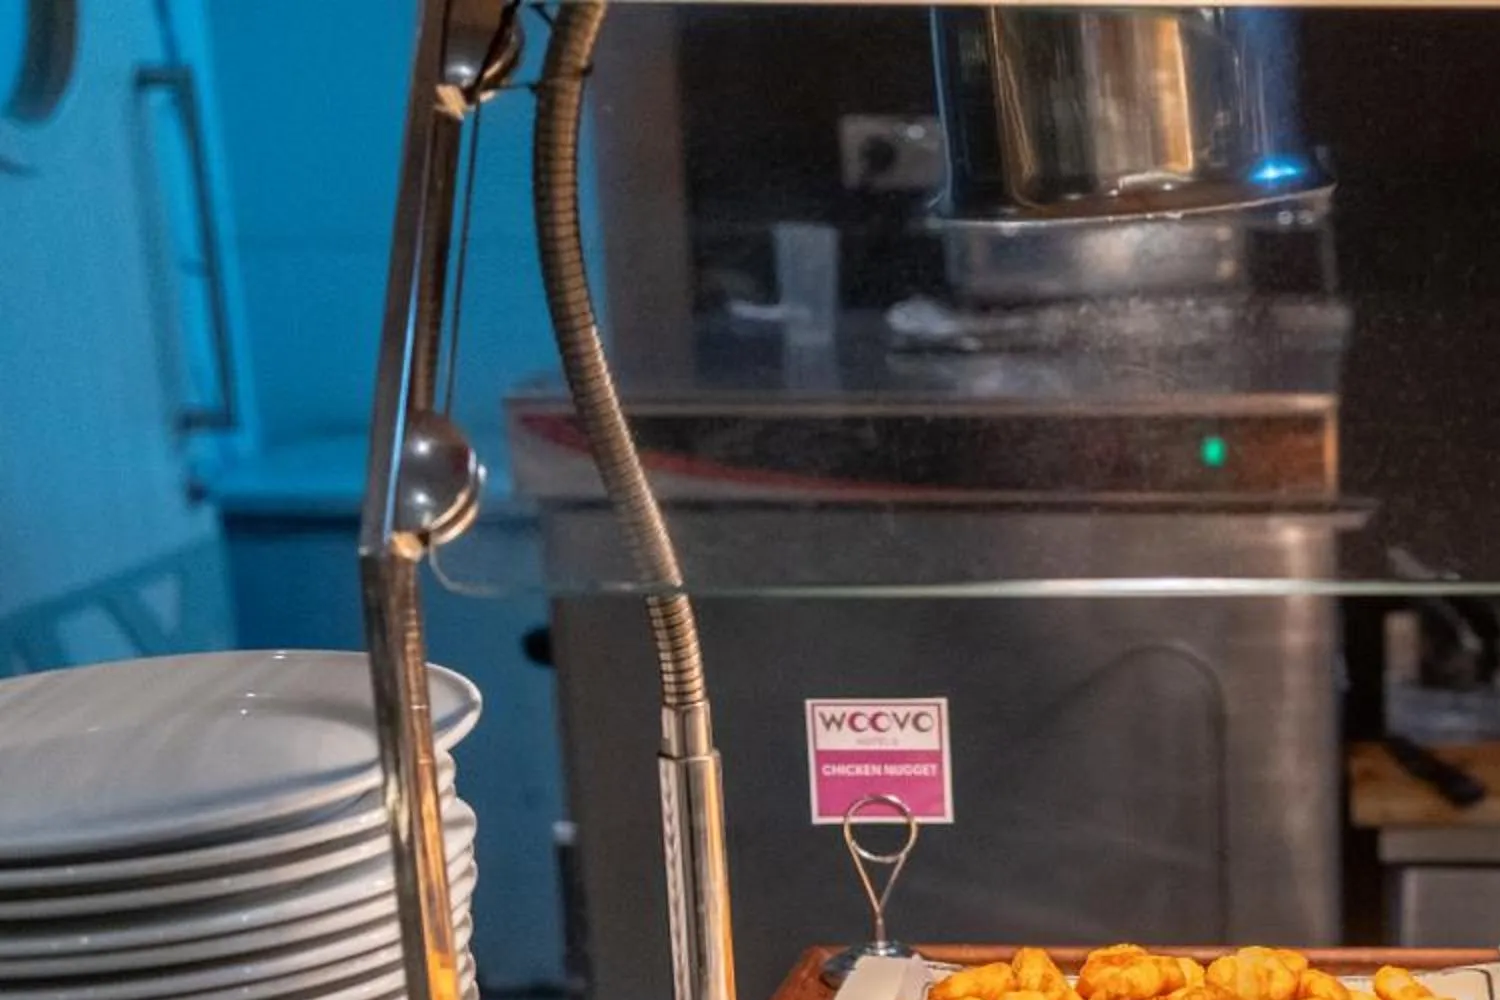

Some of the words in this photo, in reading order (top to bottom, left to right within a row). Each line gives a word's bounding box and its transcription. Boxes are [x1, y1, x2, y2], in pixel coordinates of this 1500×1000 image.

[818, 711, 934, 733] WOOVO
[821, 763, 882, 777] CHICKEN
[883, 763, 937, 777] NUGGET
